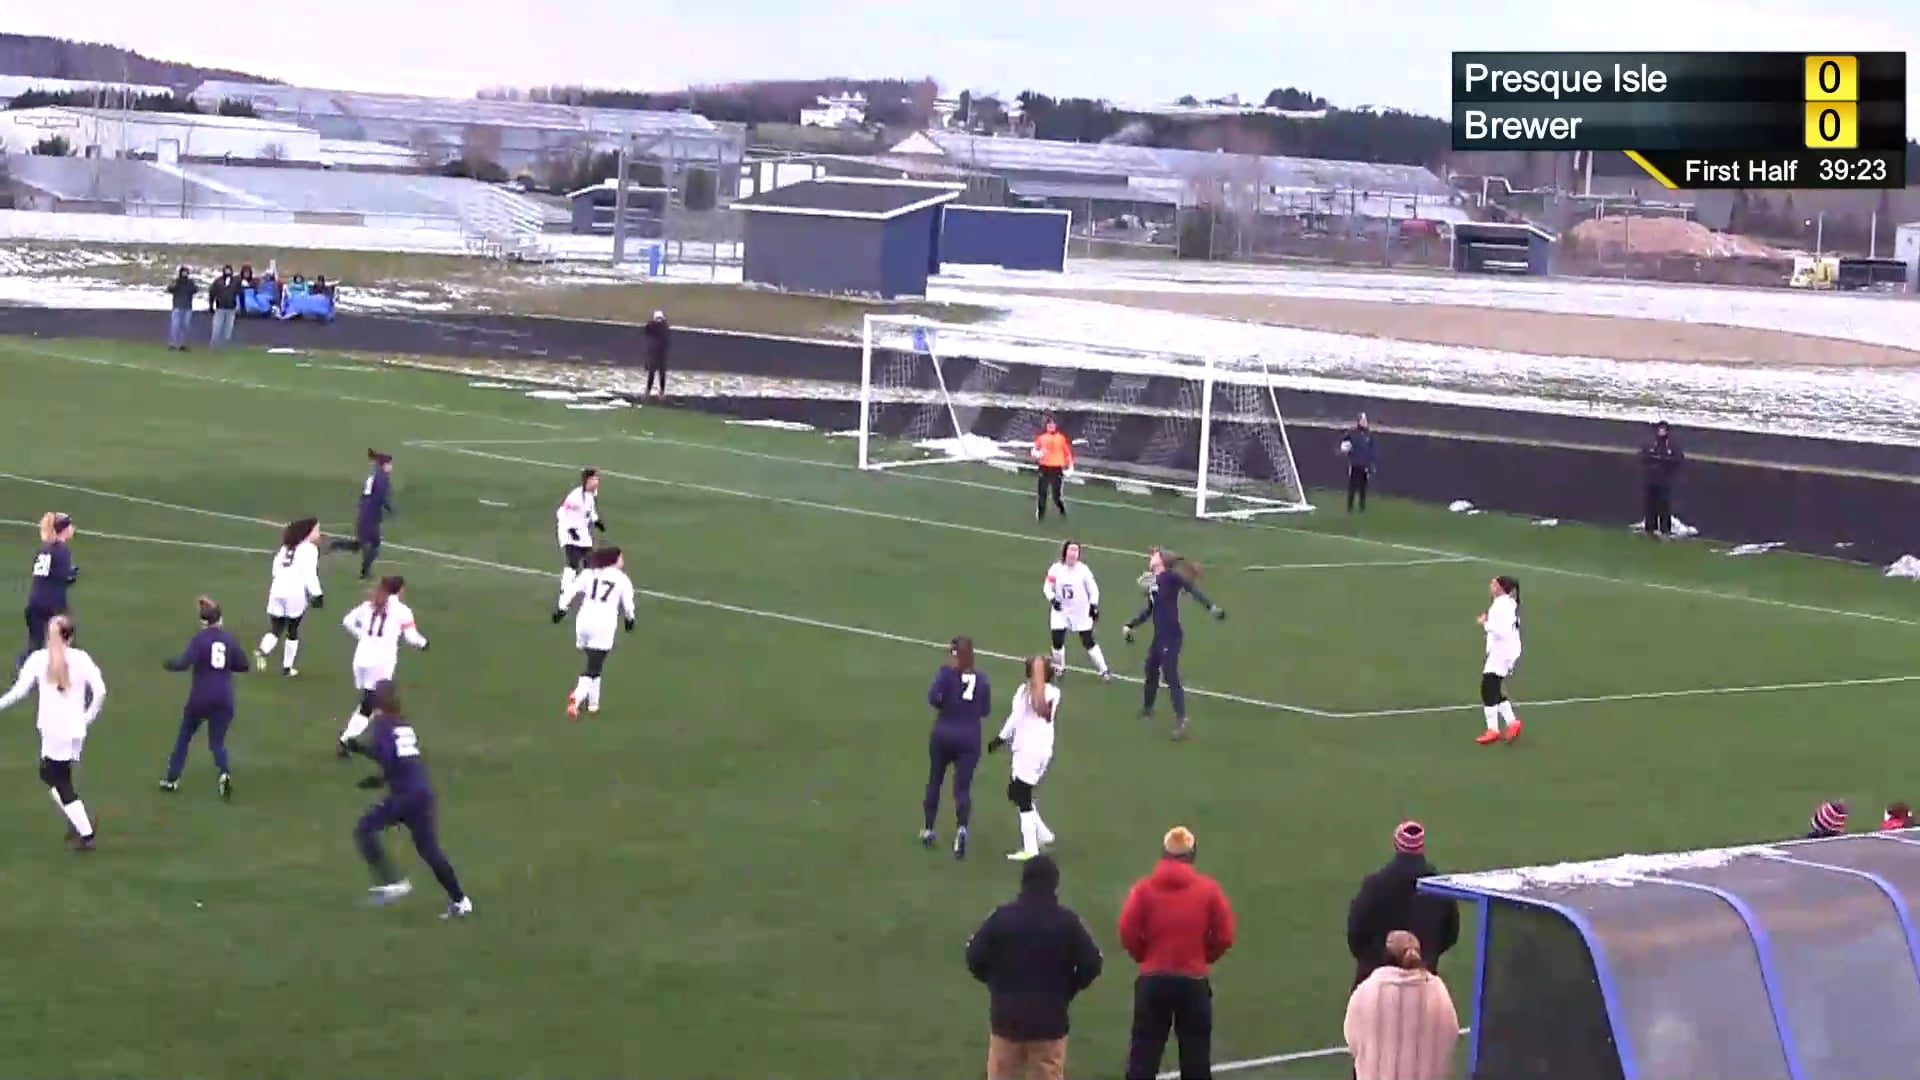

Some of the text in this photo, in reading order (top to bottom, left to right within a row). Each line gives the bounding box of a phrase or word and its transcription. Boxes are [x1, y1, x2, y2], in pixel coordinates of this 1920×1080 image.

[592, 578, 617, 603] 17
[368, 607, 387, 637] 11
[210, 641, 226, 669] 6
[961, 673, 977, 701] 7
